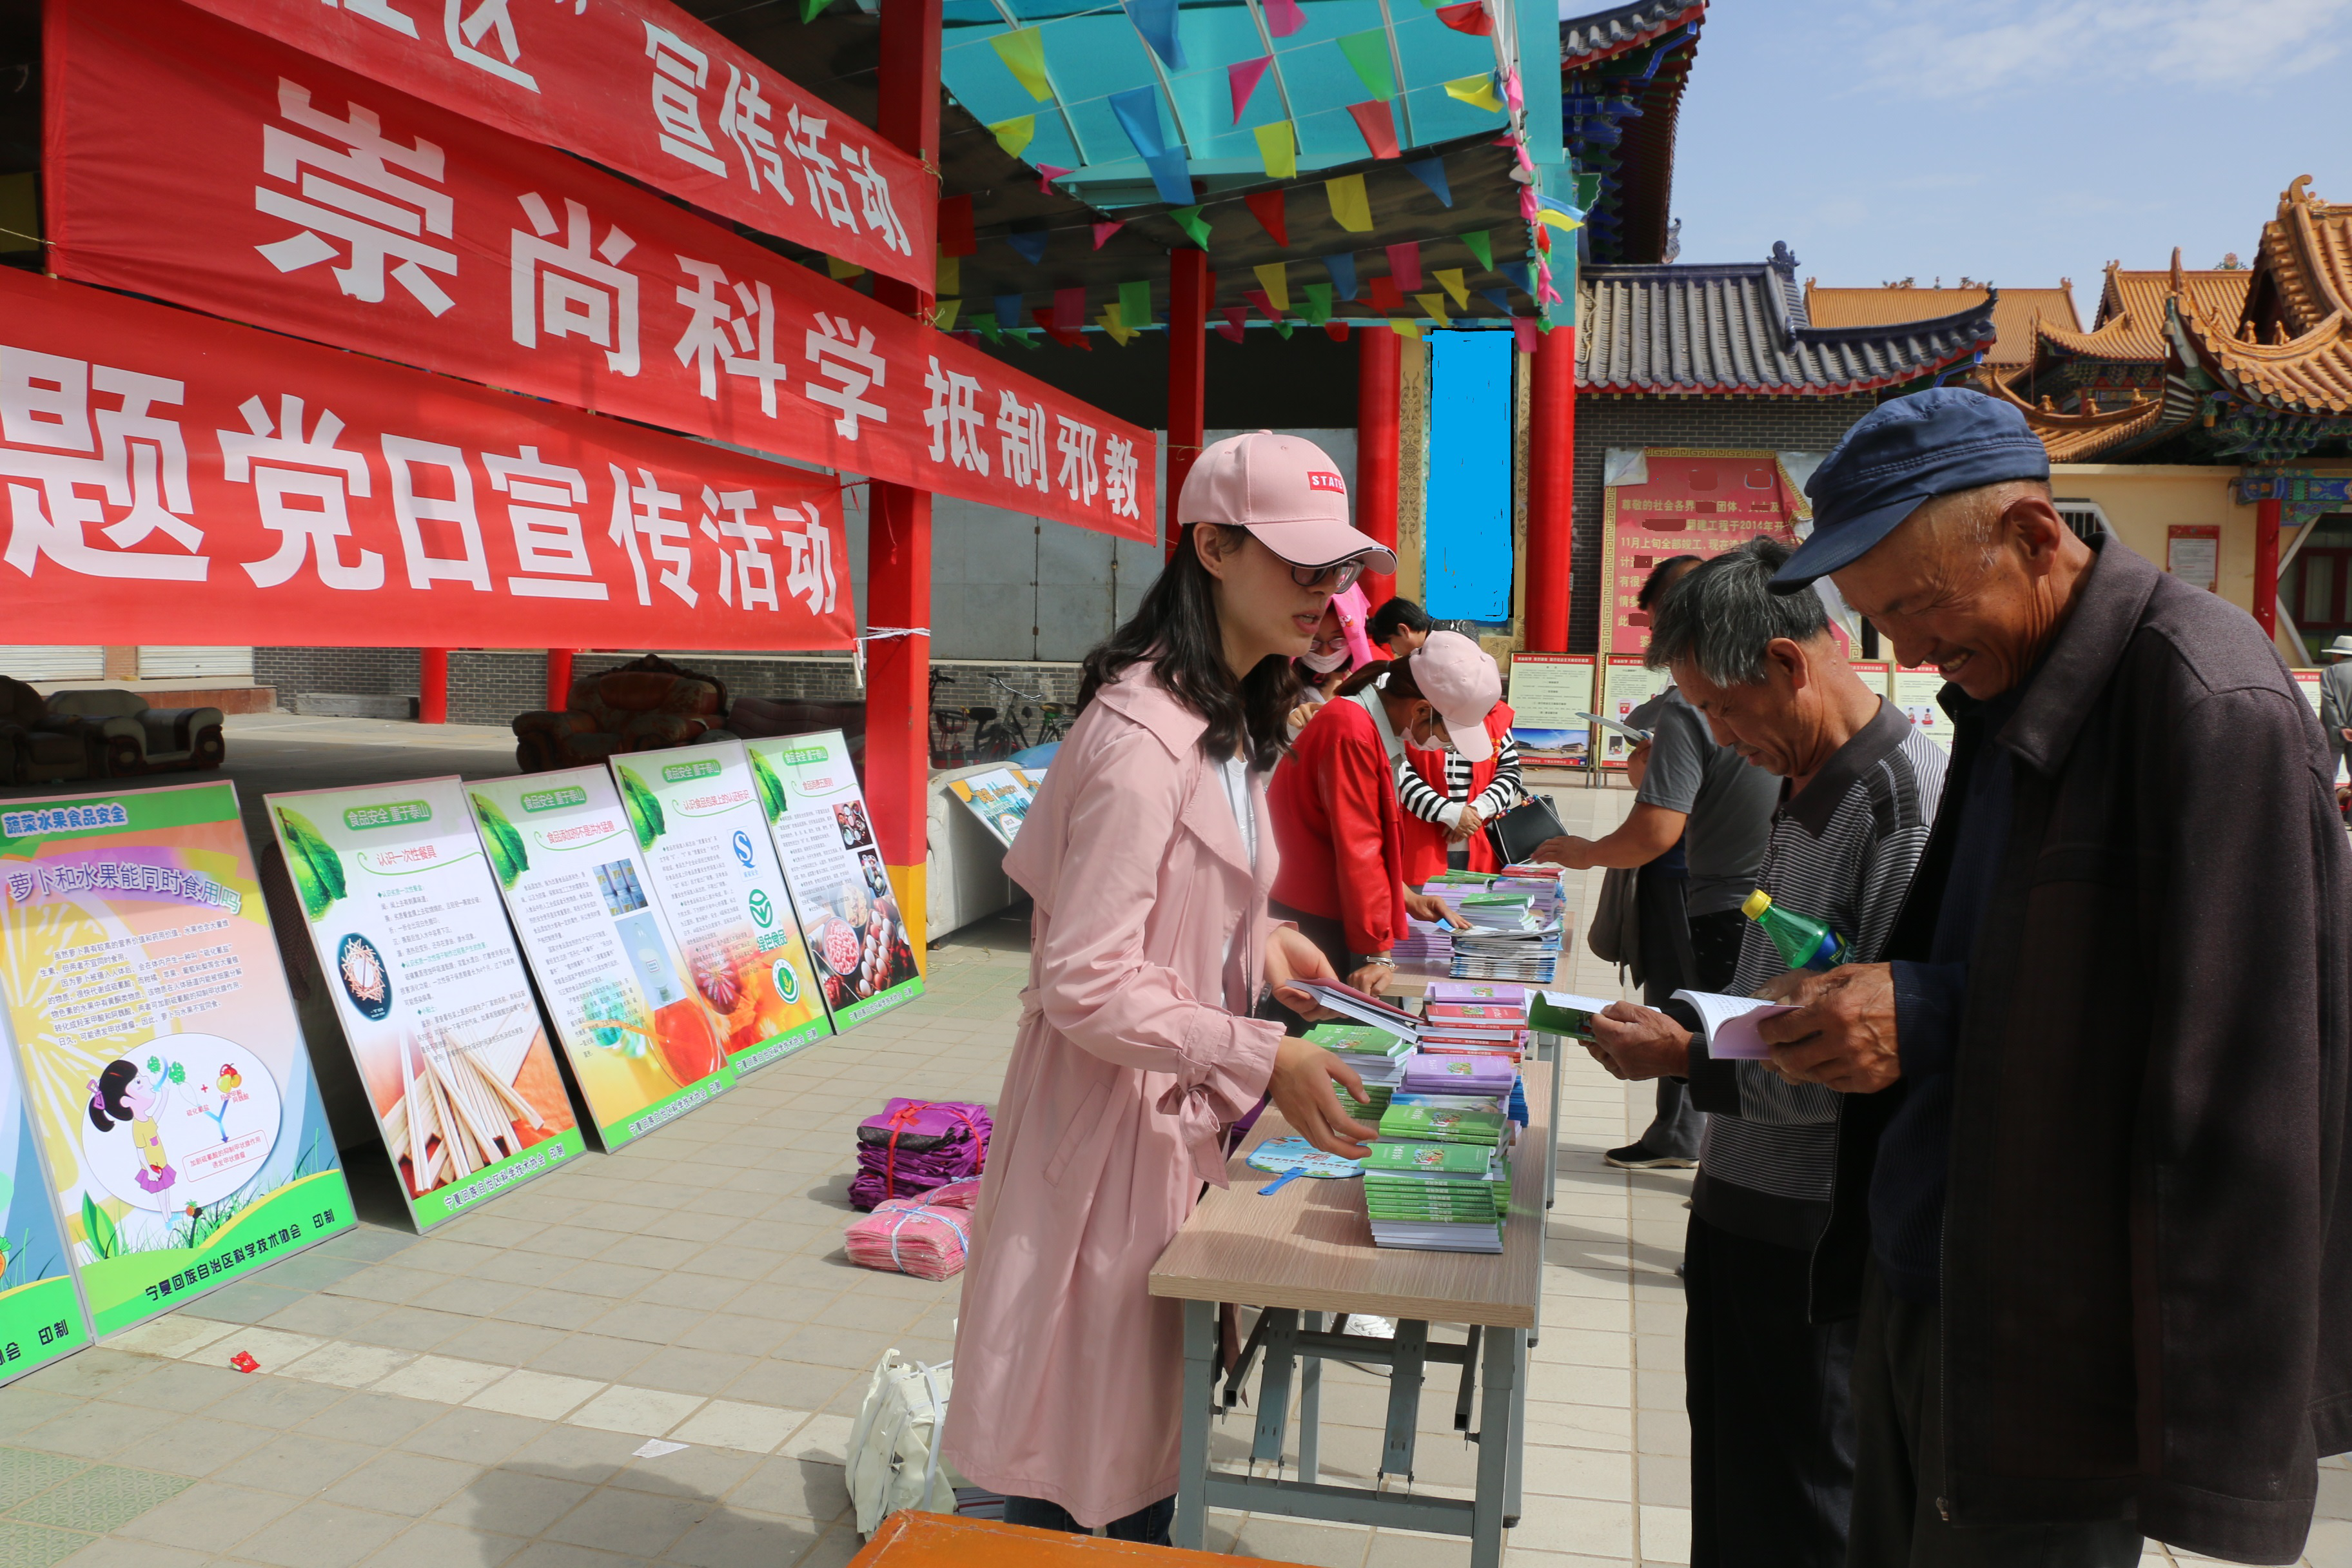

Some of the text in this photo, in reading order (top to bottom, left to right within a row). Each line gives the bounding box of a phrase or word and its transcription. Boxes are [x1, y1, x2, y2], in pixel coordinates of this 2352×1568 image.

[254, 76, 1140, 520] 崇尚科学 抵制邪教
[0, 344, 837, 616] 题党日宣传活动
[1312, 475, 1343, 489] STATE
[665, 761, 720, 781] 食品安全 重于泰山
[524, 788, 585, 810] 食品安全 重于泰山
[683, 790, 750, 811] 认识食品包装上的认证标识
[5, 806, 126, 836] 蔬菜水果食品安全
[348, 803, 430, 827] 食品安全 重于泰山
[546, 820, 616, 844] 食品添加剂不是洪水猛兽
[377, 845, 437, 867] 认识一次性餐具
[8, 861, 242, 915] 萝卜和水果能同时食用吗
[756, 929, 789, 953] 绿色食品
[736, 1034, 805, 1072] 宁夏回族自治区科学技术协会
[628, 1080, 723, 1136] 宁夏回族自治区科学技术协会 印制
[444, 1142, 564, 1211] 宁夏回族自治区科学技术协会 印制
[145, 1208, 335, 1304] 宁夏回族自治区科学技术协会 印制
[38, 1319, 69, 1346] 印制
